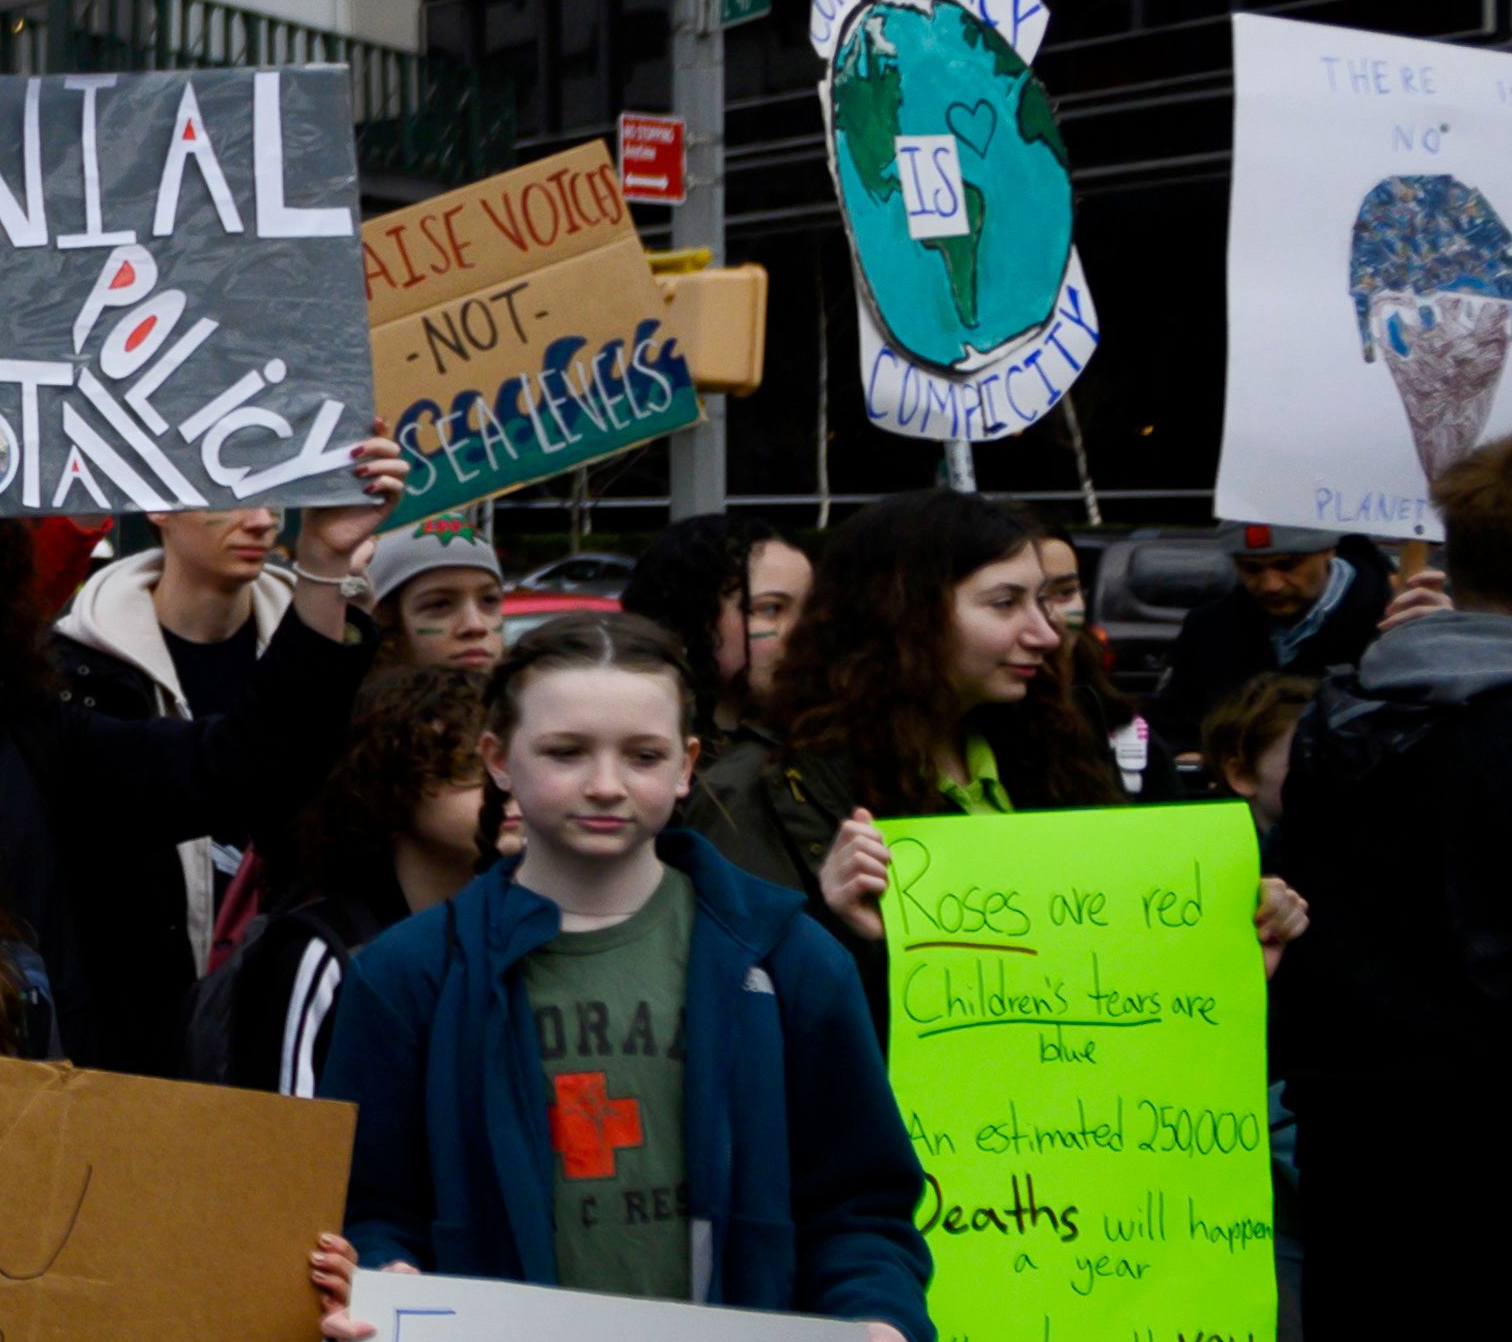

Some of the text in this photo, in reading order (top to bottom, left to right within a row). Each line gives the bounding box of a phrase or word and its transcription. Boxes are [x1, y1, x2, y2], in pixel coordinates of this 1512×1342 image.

[1319, 55, 1439, 97] THERE
[1391, 124, 1442, 155] NO
[899, 145, 959, 218] IS
[361, 162, 625, 301] AISE VOICES
[397, 338, 672, 497] SEA LEVELS
[1313, 487, 1428, 524] PLANET
[889, 836, 1203, 939] Roses are red
[901, 950, 1221, 1026] Children's tears are
[1039, 1022, 1099, 1066] blue
[975, 1096, 1125, 1156] estimated
[1138, 1099, 1261, 1158] 250,000
[1103, 1189, 1166, 1243] will
[1188, 1195, 1273, 1254] happen
[1013, 1252, 1152, 1296] a year
